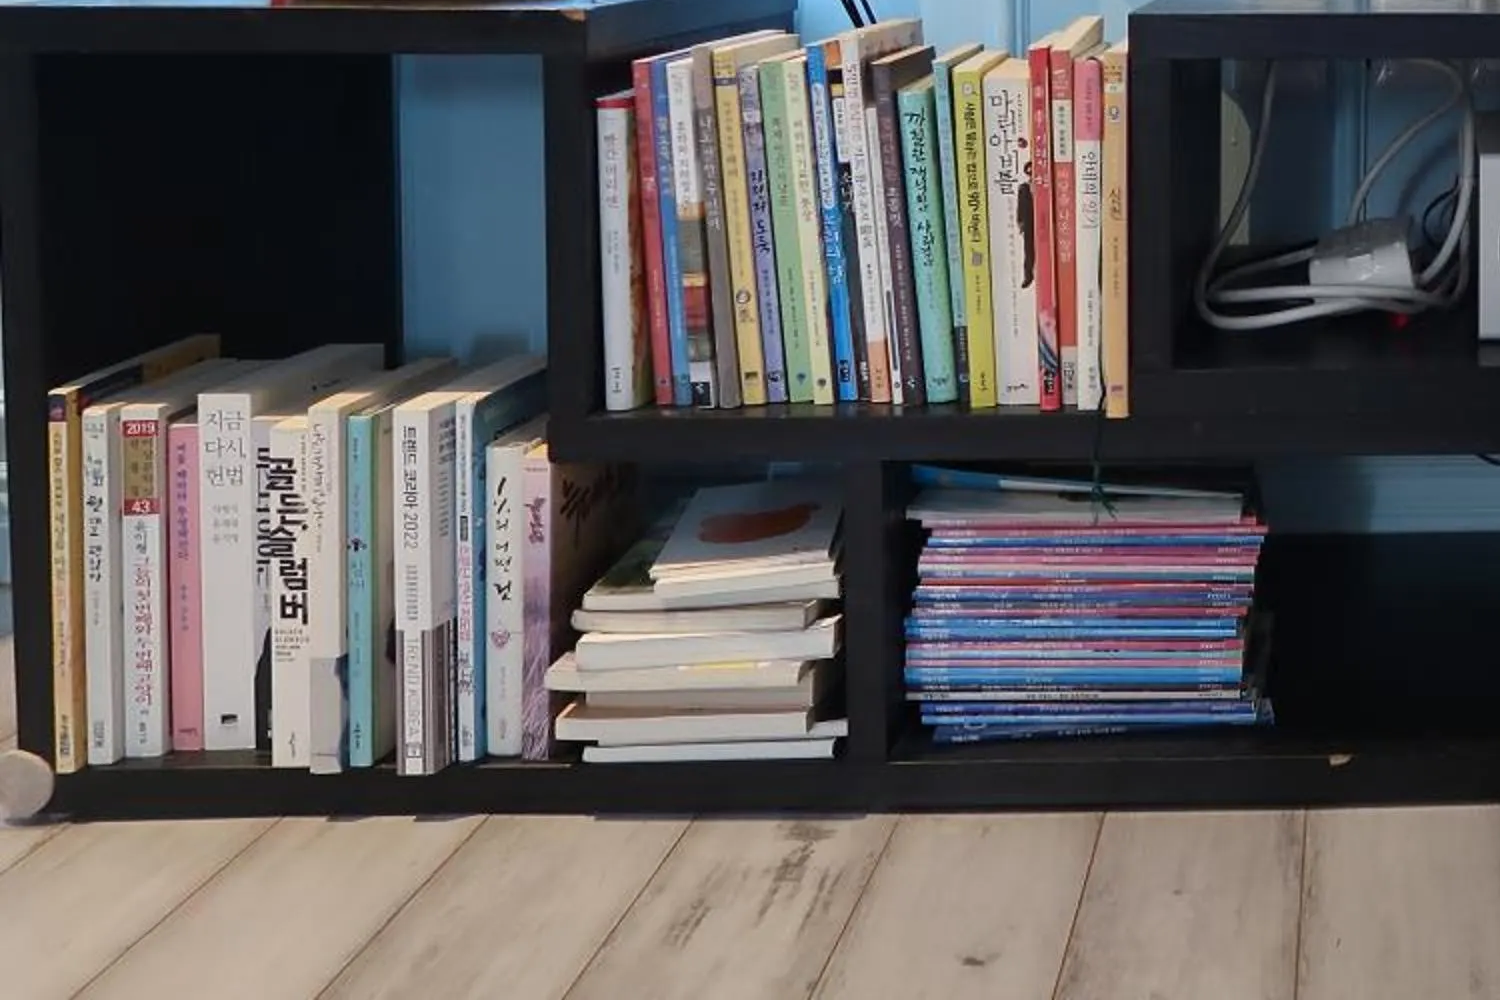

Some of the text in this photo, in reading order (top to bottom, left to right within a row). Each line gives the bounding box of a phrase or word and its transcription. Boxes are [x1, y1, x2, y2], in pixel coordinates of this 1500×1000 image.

[126, 422, 156, 435] 2019
[203, 409, 245, 432] 지금
[203, 436, 247, 460] 다시,
[402, 425, 419, 465] 트렌드
[206, 464, 244, 487] 헌법
[403, 469, 419, 510] 코리아
[131, 499, 151, 512] 43
[265, 457, 309, 627] 골든슬럼버
[403, 512, 419, 549] 2022
[493, 580, 513, 602] 것
